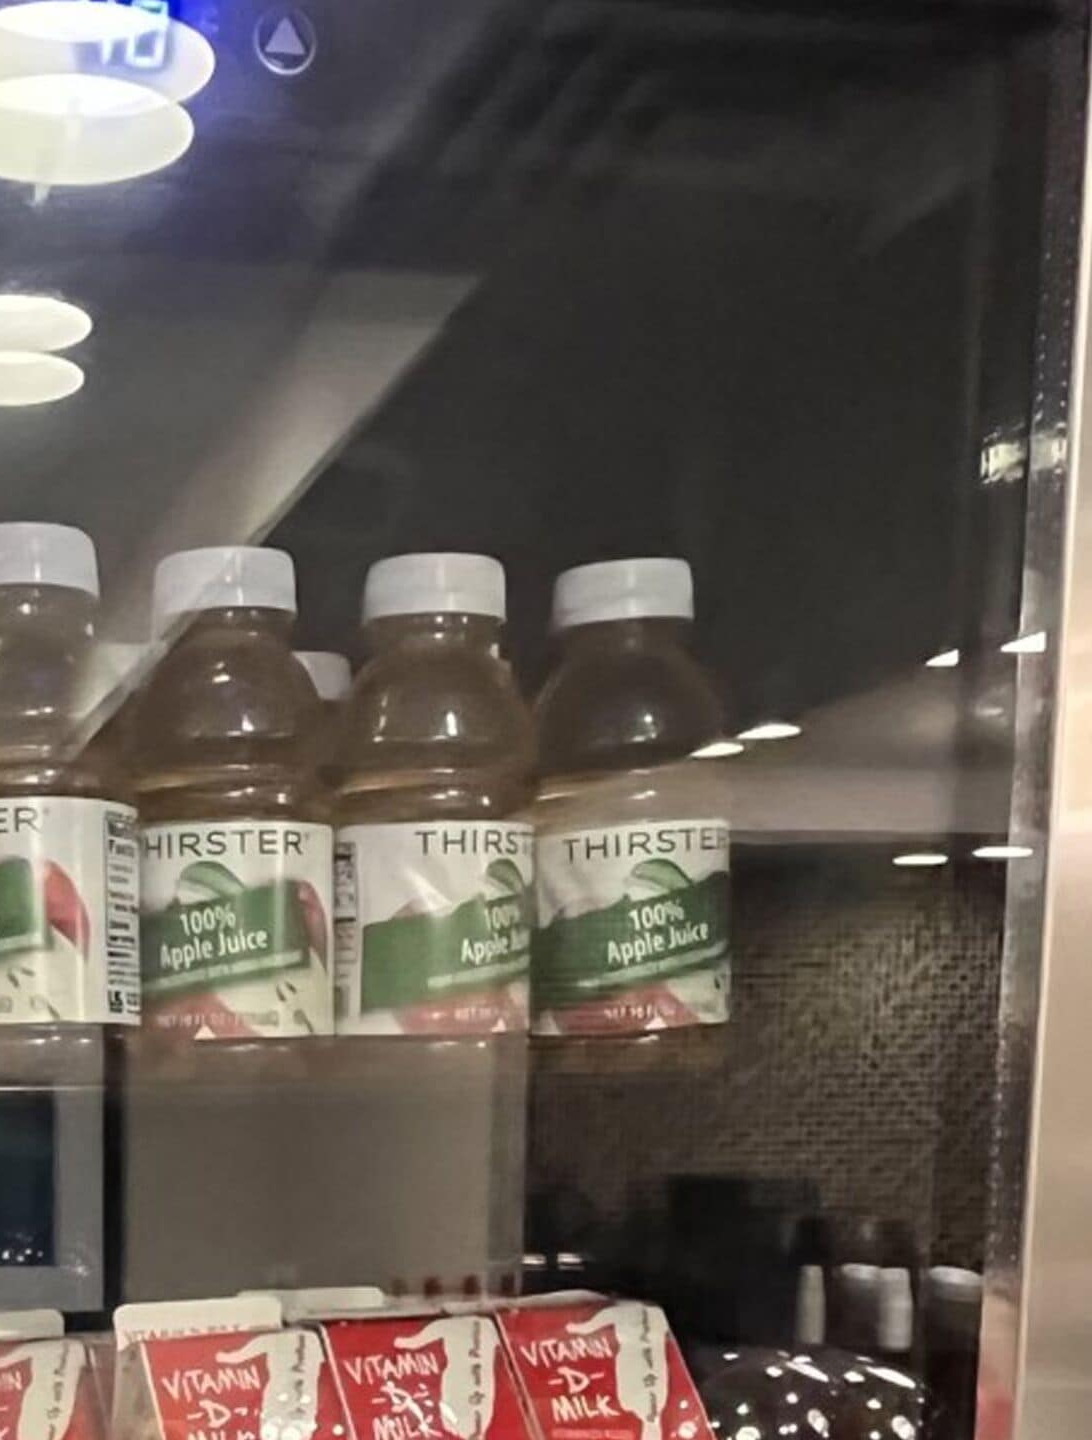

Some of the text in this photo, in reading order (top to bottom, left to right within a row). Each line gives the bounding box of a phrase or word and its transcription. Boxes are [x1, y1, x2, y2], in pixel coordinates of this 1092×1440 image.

[179, 903, 237, 936] 100%
[628, 900, 685, 931] 100%
[160, 929, 268, 970] Apple Juice
[461, 934, 510, 966] Apple
[608, 921, 709, 966] Apple Juice
[521, 1336, 613, 1368] VITAMIN
[162, 1364, 261, 1402] VITAMIN
[344, 1353, 438, 1384] VITAMIN
[551, 1395, 620, 1422] MILK
